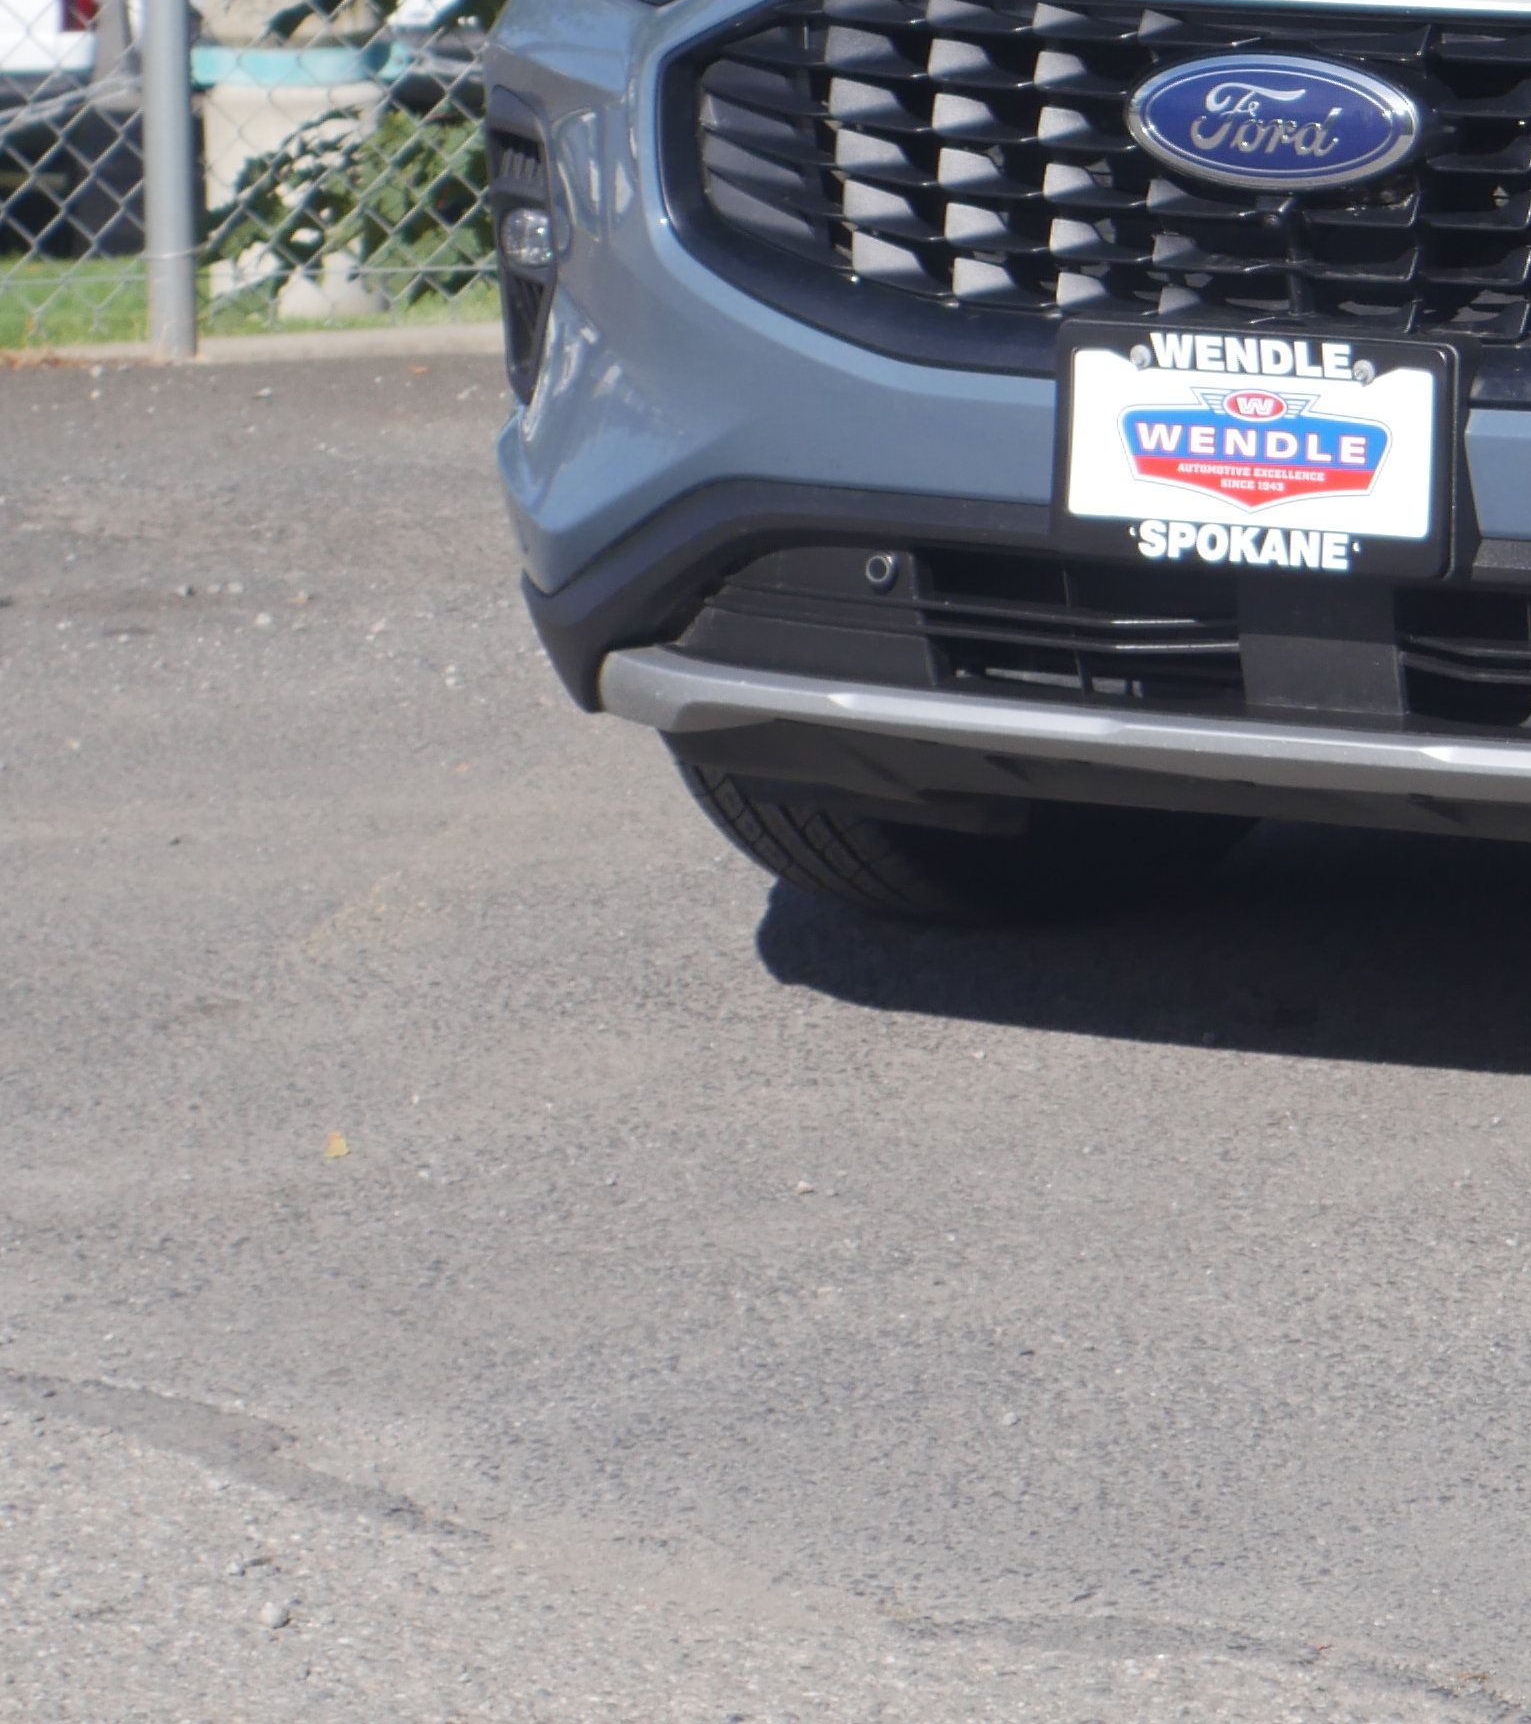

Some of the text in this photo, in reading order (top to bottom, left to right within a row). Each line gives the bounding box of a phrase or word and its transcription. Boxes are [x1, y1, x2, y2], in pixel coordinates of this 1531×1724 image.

[1190, 82, 1343, 157] Ford
[1150, 332, 1353, 379] WENDLE
[1136, 422, 1367, 464] WENDLE
[1177, 463, 1325, 482] AUTOMOTIVE EXCELLENCE
[1220, 478, 1285, 493] SINCE 1943
[1137, 520, 1350, 570] SPOKANE
